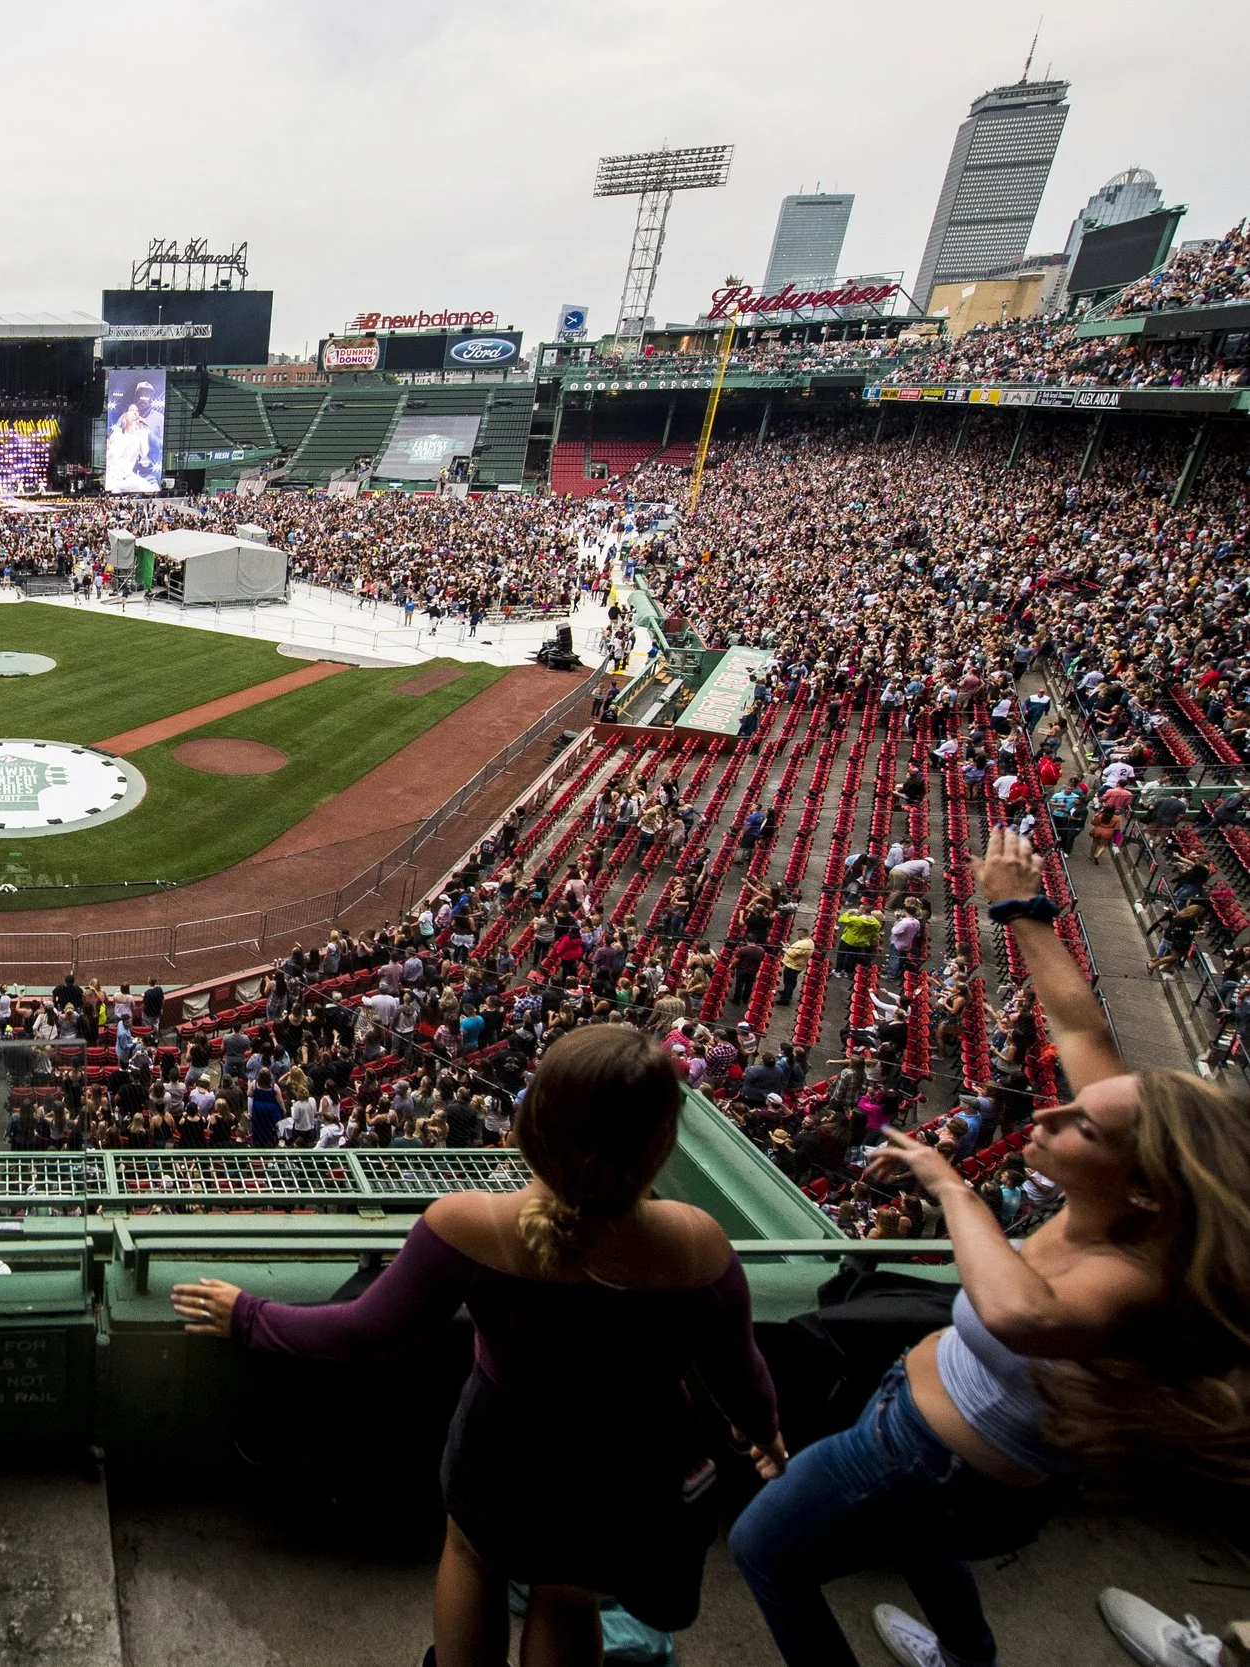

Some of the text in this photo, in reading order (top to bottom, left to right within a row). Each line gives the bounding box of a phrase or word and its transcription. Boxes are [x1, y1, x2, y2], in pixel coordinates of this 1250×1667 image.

[1001, 89, 1054, 98] PRUDENTIAL
[133, 237, 249, 285] John Hancock
[708, 279, 900, 321] Budweiser
[339, 348, 377, 357] DUNKIN'
[462, 342, 502, 359] Ford
[339, 356, 373, 364] DONUTS
[1079, 393, 1094, 405] ALEX
[1093, 393, 1110, 405] AND
[714, 671, 751, 692] RED
[688, 689, 743, 730] BOSTON
[5, 1340, 46, 1352] FOR
[25, 1357, 38, 1369] &
[6, 1375, 46, 1387] NOT
[14, 1391, 58, 1403] RAIL
